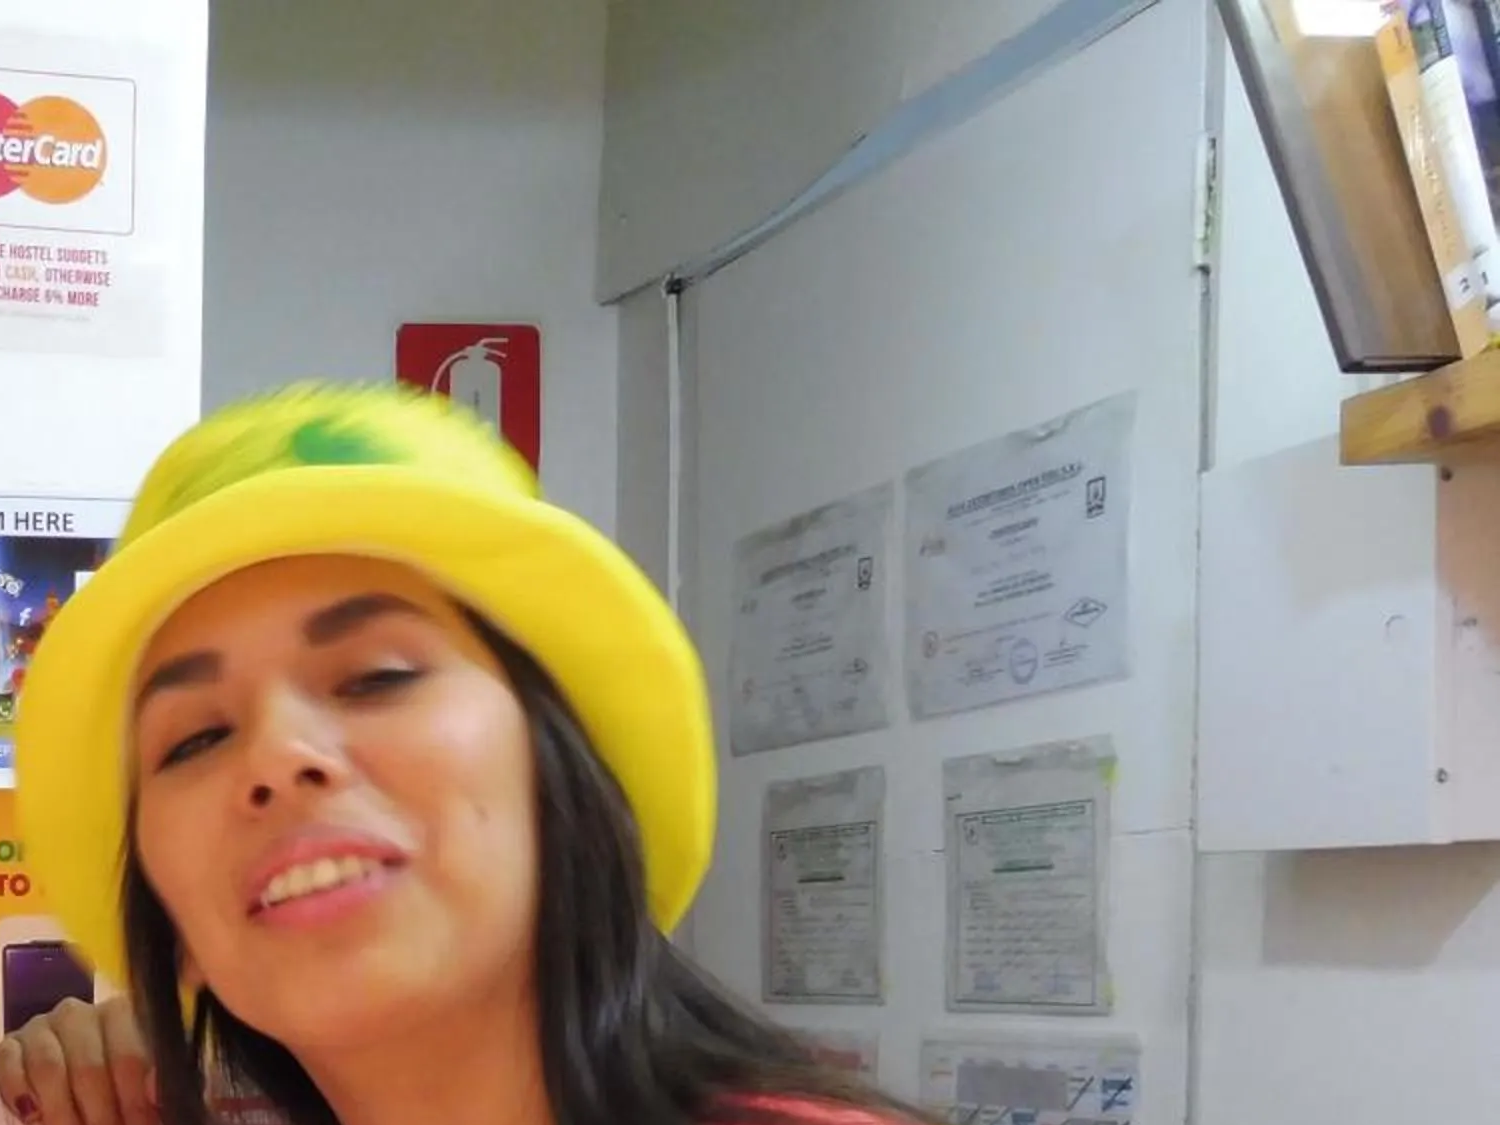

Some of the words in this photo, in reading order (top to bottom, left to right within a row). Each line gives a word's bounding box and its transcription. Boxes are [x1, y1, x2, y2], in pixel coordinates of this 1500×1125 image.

[10, 244, 52, 261] HOSTEL
[45, 268, 111, 287] OTHERWISE
[67, 291, 100, 307] MORE
[14, 512, 74, 532] HERE
